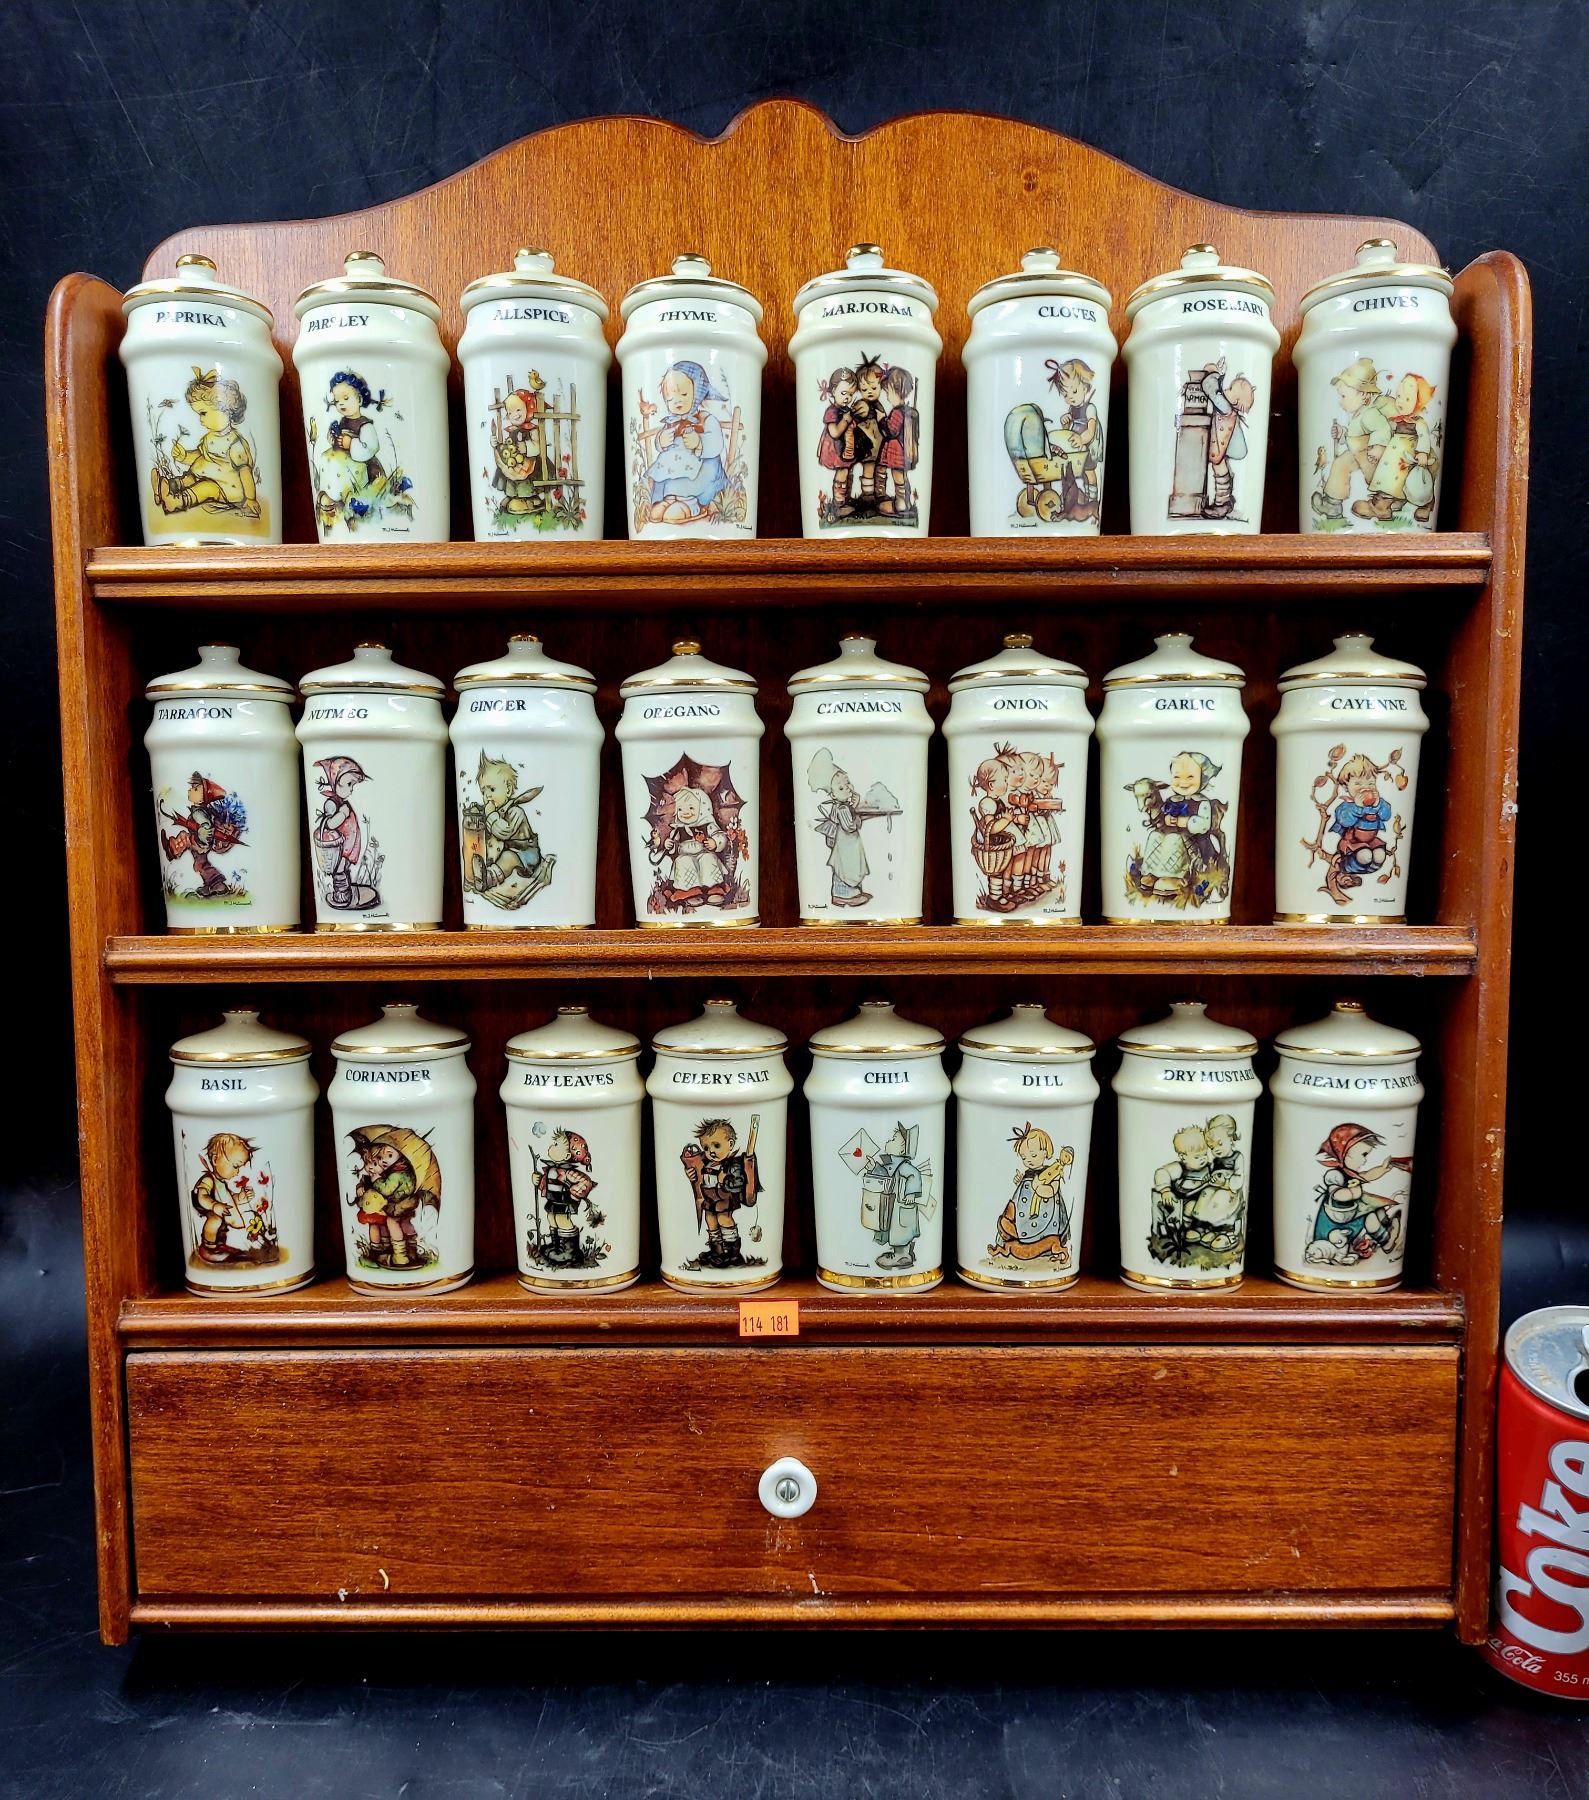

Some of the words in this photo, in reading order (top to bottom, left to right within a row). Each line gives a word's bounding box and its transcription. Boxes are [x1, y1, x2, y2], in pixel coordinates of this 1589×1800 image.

[822, 304, 913, 319] MARJORAM
[1353, 296, 1418, 312] CHIVES
[156, 312, 227, 328] PPRIKA
[493, 309, 572, 324] ALLSPICE
[659, 310, 718, 322] THYME
[470, 699, 527, 712] GINGER
[643, 704, 721, 720] OREGANO
[816, 700, 903, 714] CINNAMON
[993, 698, 1048, 712] ONION
[1155, 698, 1216, 711] GARLIC
[1330, 697, 1408, 712] CAYENNE
[158, 706, 234, 722] TARRAGON
[307, 707, 368, 722] NUTMEG
[345, 1067, 432, 1085] CORIANDER
[523, 1072, 551, 1087] BAY
[552, 1071, 615, 1088] LEAVES
[671, 1070, 734, 1087] CELERY
[736, 1068, 771, 1086] SALT
[863, 1071, 911, 1085] CHILI
[1022, 1074, 1064, 1088] DILL
[1163, 1068, 1196, 1082] DRY
[1291, 1072, 1350, 1089] CREAM
[1353, 1077, 1379, 1089] OF
[200, 1078, 248, 1093] BASIL
[742, 1316, 763, 1333] 114
[770, 1315, 789, 1332] 181
[1499, 1439, 1589, 1655] Coke
[1553, 1670, 1579, 1684] 355
